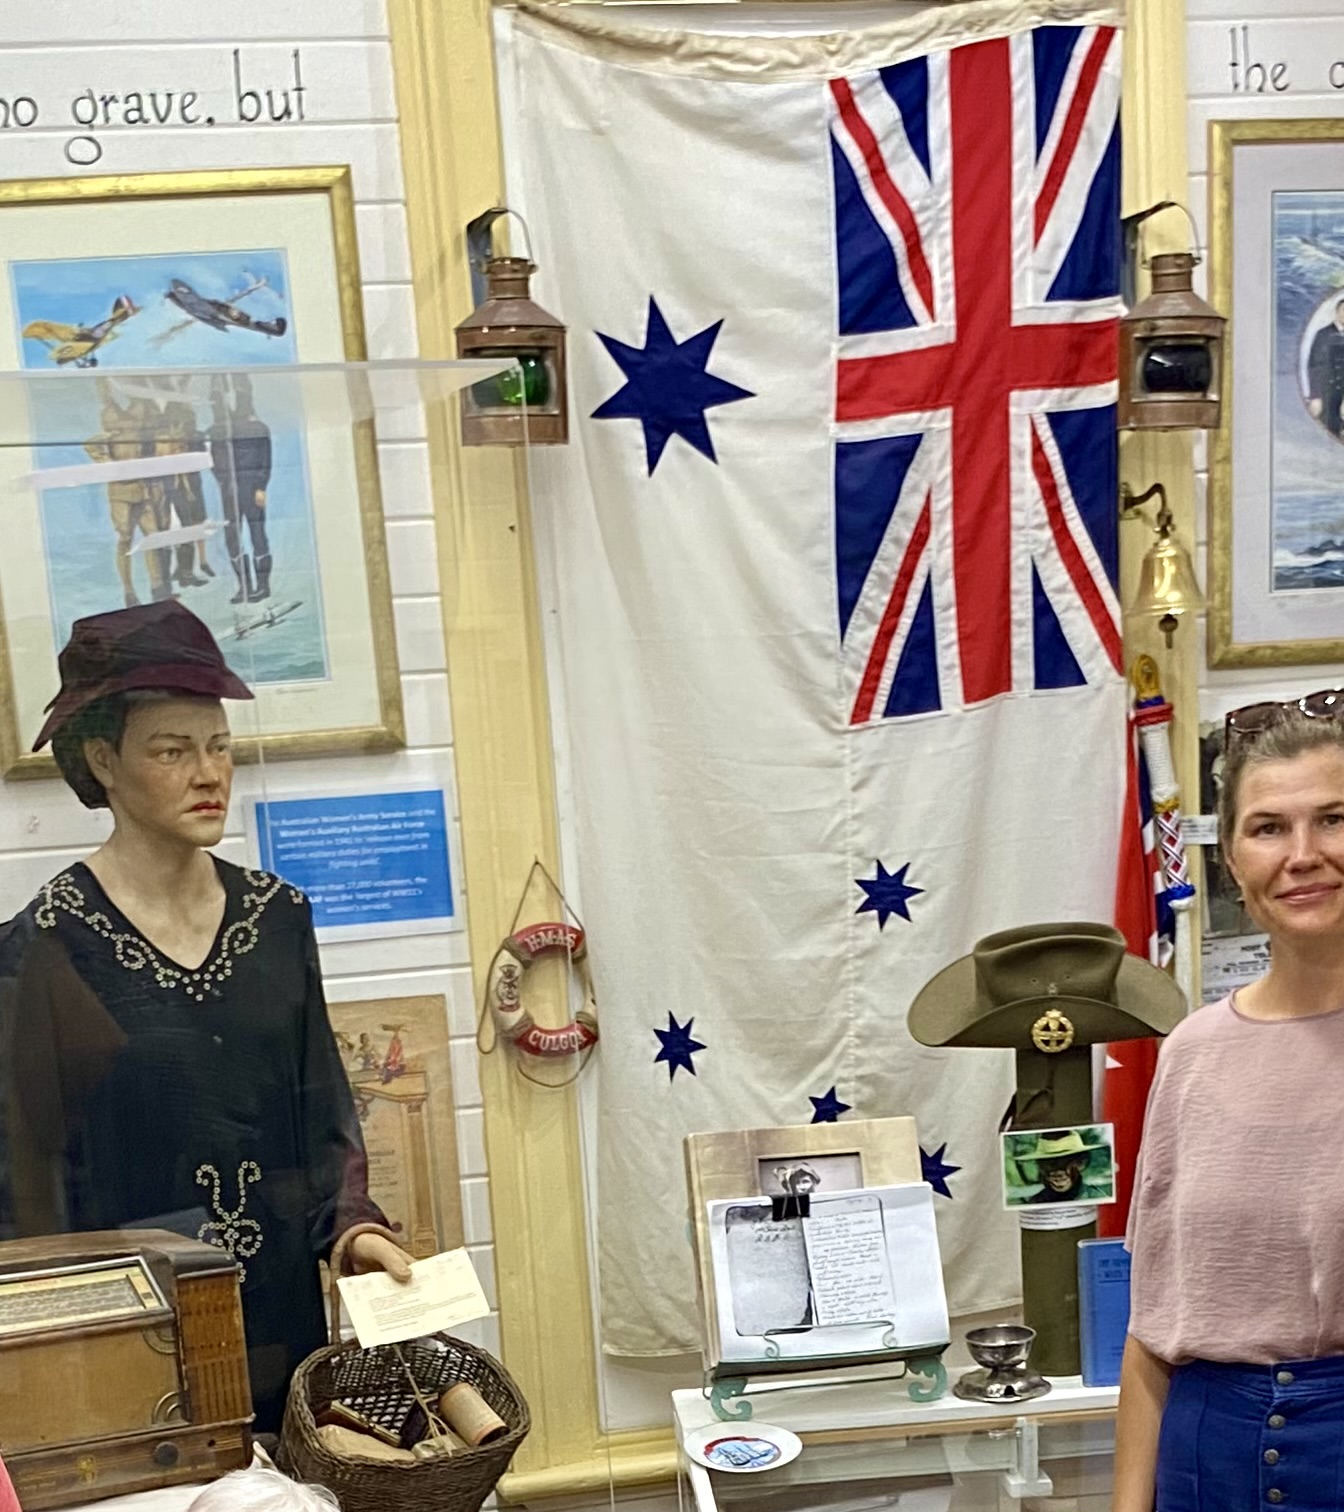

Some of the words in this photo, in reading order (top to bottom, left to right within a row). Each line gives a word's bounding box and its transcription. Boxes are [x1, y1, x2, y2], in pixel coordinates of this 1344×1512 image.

[233, 48, 308, 125] but
[1229, 26, 1290, 94] the
[528, 1030, 587, 1051] CULGOA
